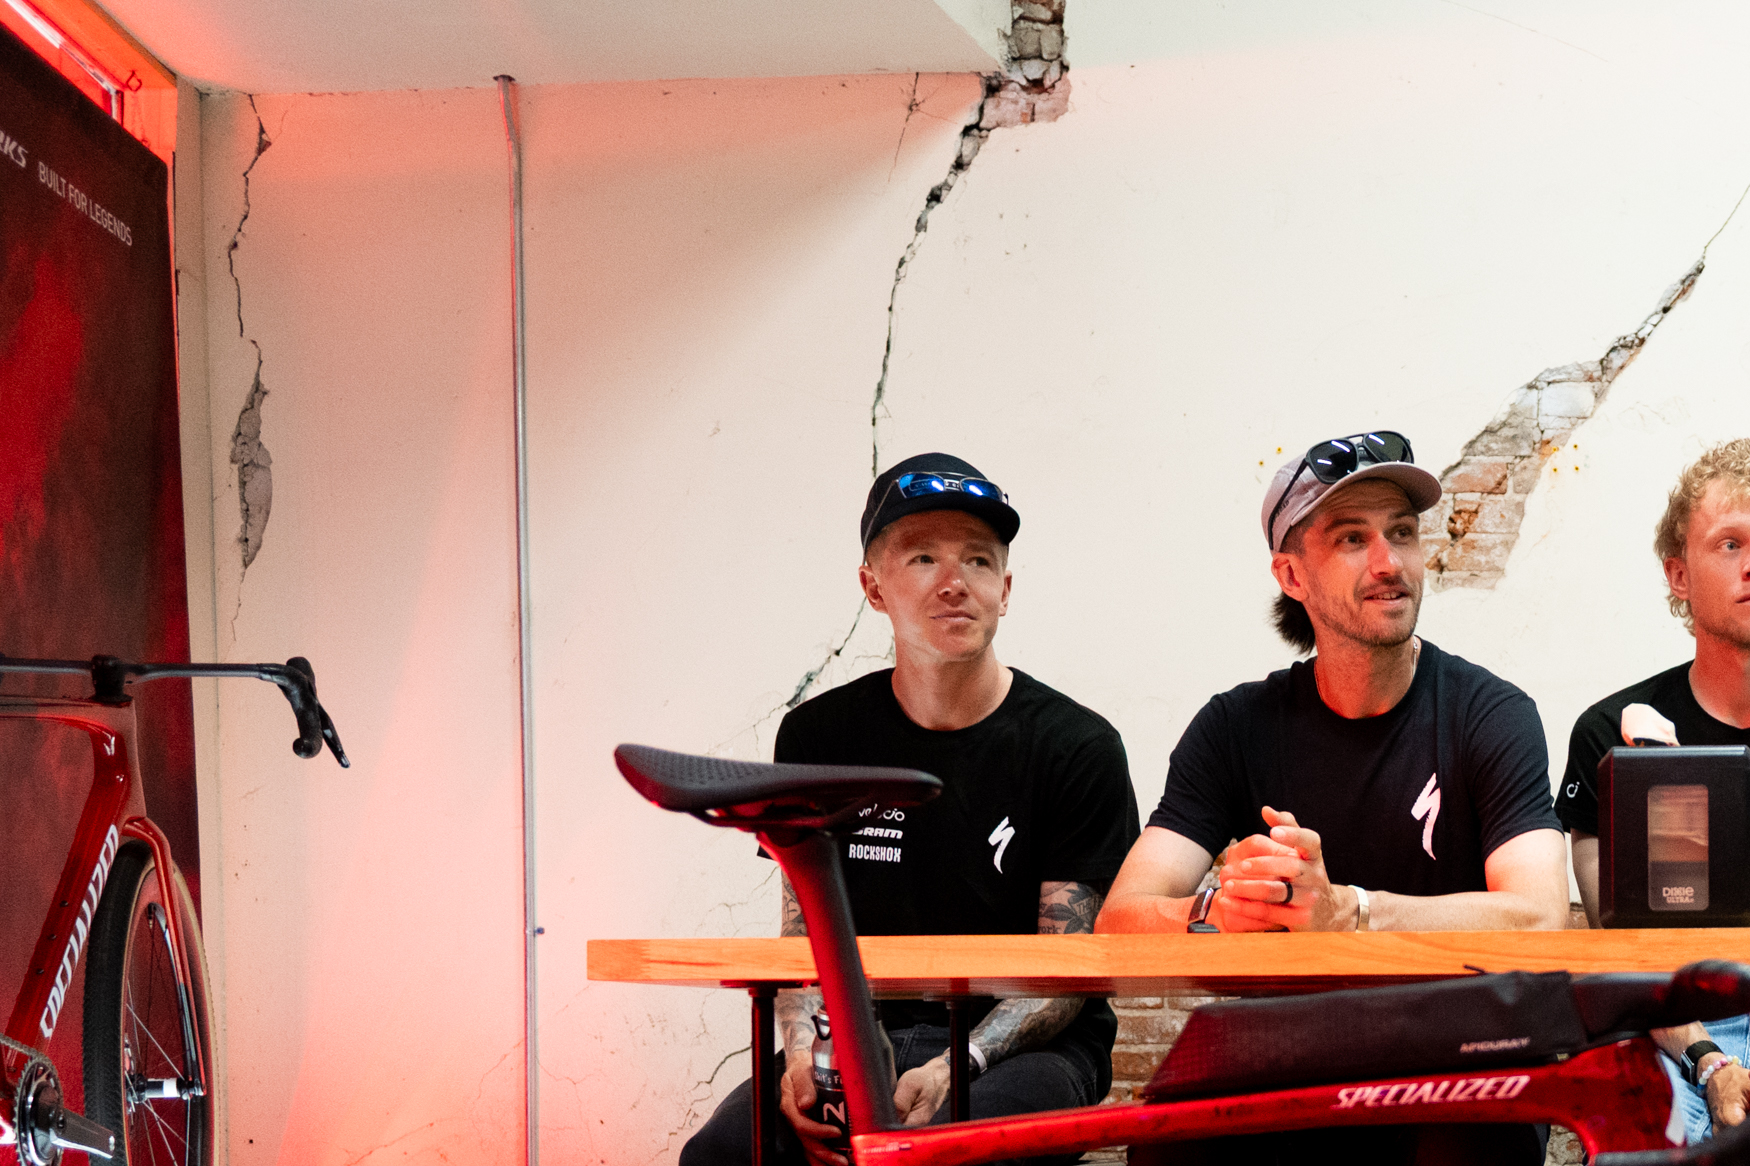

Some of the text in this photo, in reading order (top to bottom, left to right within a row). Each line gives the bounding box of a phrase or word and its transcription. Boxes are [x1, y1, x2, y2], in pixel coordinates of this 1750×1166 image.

[38, 160, 66, 198] BUILT
[68, 183, 88, 215] FOR
[89, 199, 133, 246] LEGENDS
[848, 843, 902, 863] ROCKSHOX
[1330, 1075, 1530, 1110] SPECIALIZED
